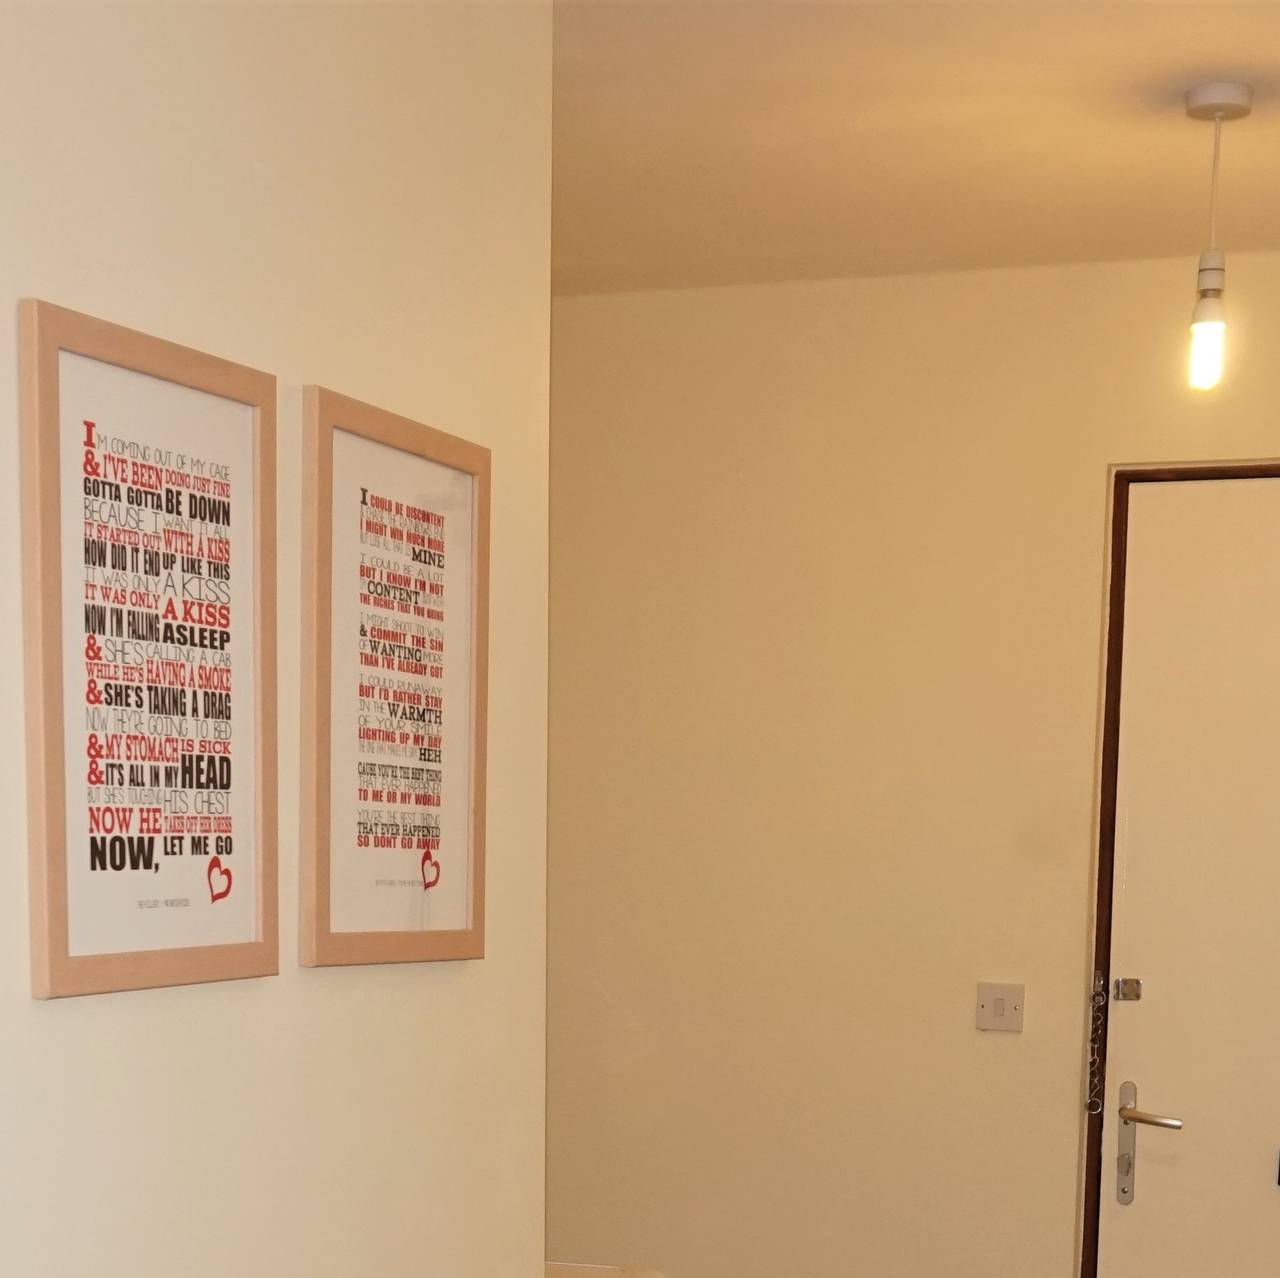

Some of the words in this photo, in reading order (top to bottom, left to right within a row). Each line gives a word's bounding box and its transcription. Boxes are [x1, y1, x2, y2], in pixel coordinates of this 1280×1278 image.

[83, 420, 107, 448] I'M
[111, 437, 151, 462] COMING
[154, 449, 172, 467] OUT
[177, 454, 186, 470] OF
[191, 458, 206, 475] MY
[210, 462, 231, 481] CAGE
[83, 449, 100, 477] &
[103, 453, 128, 483] I'VE
[132, 461, 163, 490] BEEN
[165, 469, 190, 488] DOING
[192, 473, 210, 494] JUST
[214, 481, 230, 498] FINE
[83, 477, 121, 502] GOTTA
[127, 487, 163, 511] GOTTA
[165, 488, 182, 516] BE
[189, 494, 230, 526] DOWN
[84, 497, 145, 531] BECAUSE
[152, 512, 160, 534] I
[361, 487, 368, 505] I
[370, 495, 392, 513] COULD
[395, 502, 403, 515] BE
[406, 505, 444, 528] DISCONTENT
[84, 521, 94, 537] IT
[97, 524, 139, 546] STARTED
[142, 532, 162, 550] OUT
[163, 528, 193, 554] WITH
[197, 535, 204, 558] A
[207, 537, 230, 562] KISS
[412, 547, 444, 568] MINE
[84, 538, 106, 568] HOW
[111, 543, 127, 571] DID
[131, 547, 139, 573] IT
[144, 549, 160, 577] END
[163, 552, 176, 570] UP
[181, 556, 202, 575] LIKE
[207, 561, 230, 581] THIS
[164, 572, 177, 596] A
[182, 575, 230, 605] KISS
[368, 581, 420, 605] CONTENT
[85, 583, 97, 600] IT
[100, 585, 127, 605] WAS
[130, 590, 160, 610] ONLY
[162, 598, 177, 620] A
[182, 600, 230, 628] KISS
[85, 604, 106, 635] NOW
[110, 607, 123, 637] I'M
[127, 610, 160, 643] FALLING
[163, 622, 230, 651] ASLEEP
[360, 624, 367, 637] &
[370, 626, 407, 644] COMMIT
[411, 635, 425, 649] THE
[430, 639, 443, 652] SIN
[85, 634, 102, 661] &
[105, 639, 144, 665] SHE'S
[146, 643, 194, 662] CALLING
[200, 651, 207, 665] A
[212, 652, 231, 667] CAB
[369, 640, 421, 662] WANTING
[86, 662, 119, 680] WHILE
[123, 665, 144, 683] HE'S
[146, 659, 185, 687] HAVING
[188, 664, 195, 688] A
[198, 665, 231, 691] SMOKE
[86, 679, 102, 705] &
[104, 683, 143, 708] SHE'S
[147, 685, 186, 717] TAKING
[191, 690, 199, 718] A
[204, 690, 231, 720] DRAG
[359, 685, 375, 698] BUT
[379, 688, 389, 701] I'D
[393, 690, 421, 705] RATHER
[425, 695, 442, 709] STAY
[148, 716, 188, 737] GOING
[194, 718, 208, 739] TO
[214, 720, 231, 740] BED
[388, 703, 442, 725] WARMTH
[88, 734, 104, 759] &
[105, 734, 122, 760] MY
[126, 734, 179, 763] STOMACH
[181, 739, 194, 752] IS
[199, 740, 231, 755] SICK
[359, 727, 395, 743] LIGHTING
[400, 733, 409, 745] UP
[414, 734, 424, 746] MY
[428, 736, 442, 748] DAY
[419, 747, 441, 763] HEH
[88, 759, 104, 785] &
[106, 763, 124, 786] IT'S
[129, 764, 145, 787] ALL
[150, 765, 160, 787] IN
[165, 766, 179, 788] MY
[181, 754, 231, 789] HEAD
[164, 790, 188, 814] HIS
[194, 791, 231, 814] CHEST
[89, 806, 133, 834] NOW
[139, 808, 162, 834] HE
[90, 836, 159, 873] NOW,
[164, 836, 184, 855] LET
[191, 836, 209, 855] ME
[216, 836, 232, 855] GO
[357, 835, 369, 847] SO
[401, 837, 412, 849] GO
[417, 838, 440, 850] AWAY
